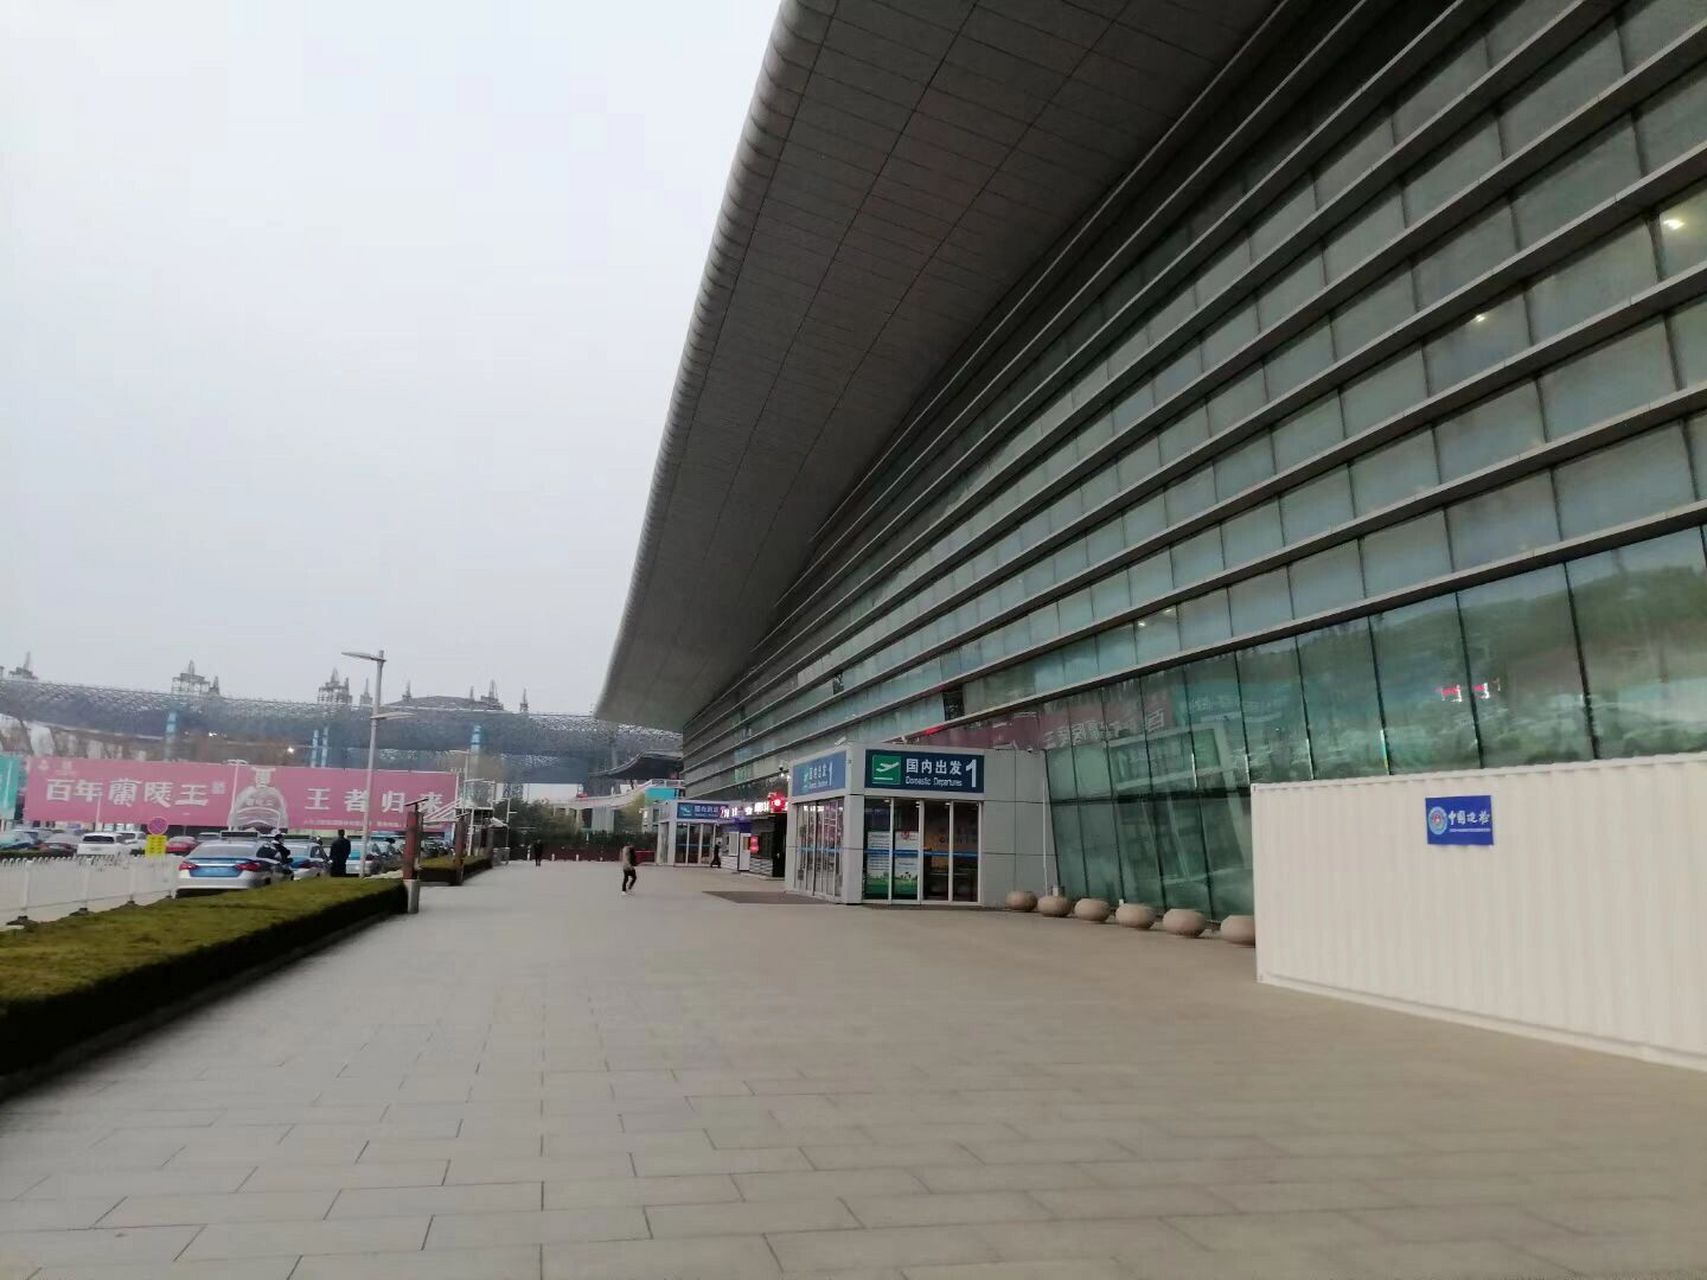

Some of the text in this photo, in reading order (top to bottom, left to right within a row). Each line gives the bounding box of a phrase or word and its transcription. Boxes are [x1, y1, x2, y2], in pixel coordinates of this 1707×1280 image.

[905, 775, 962, 787] Domestic Departures
[906, 758, 977, 788] 国内出发 1
[304, 788, 444, 813] 王者归来
